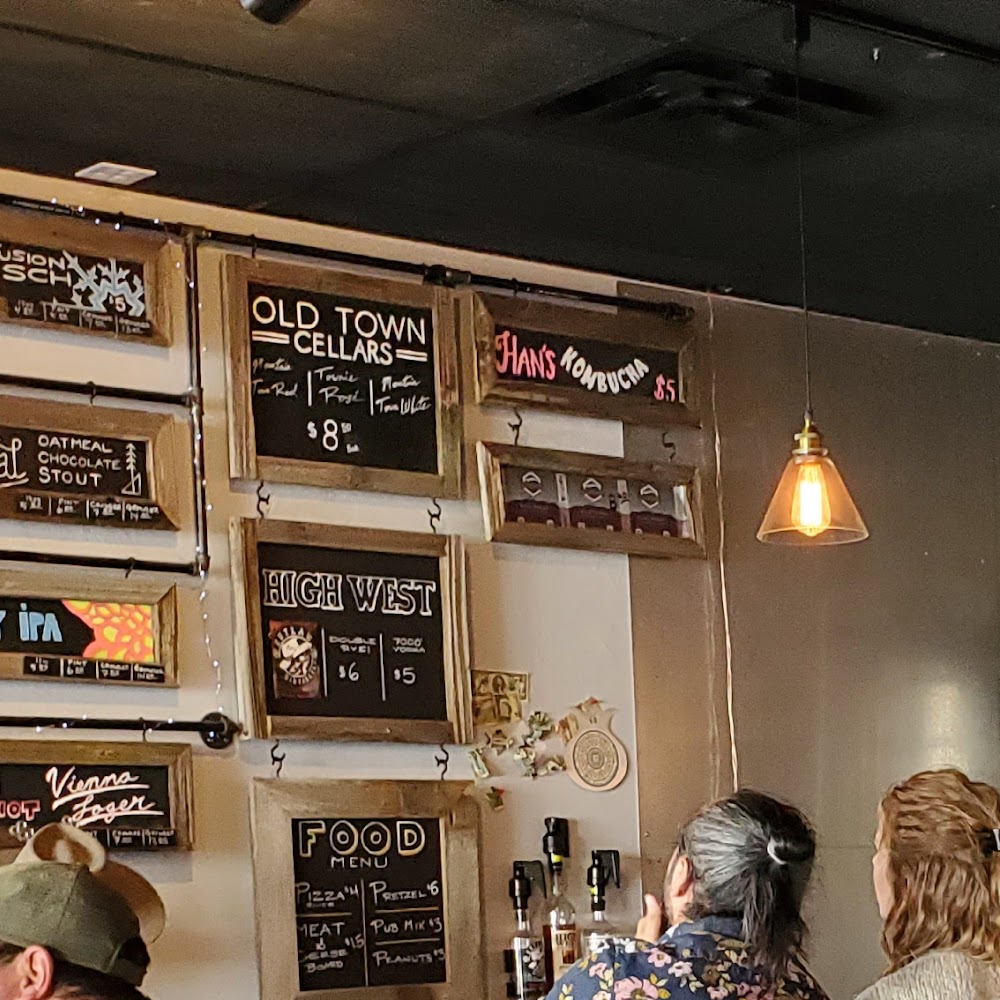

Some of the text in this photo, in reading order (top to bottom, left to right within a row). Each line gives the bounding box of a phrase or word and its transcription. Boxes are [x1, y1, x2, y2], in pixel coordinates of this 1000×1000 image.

[253, 295, 426, 345] OLD TOWN
[293, 330, 393, 366] CELLARS
[37, 434, 114, 454] OATMEAL
[37, 450, 122, 471] CHOCOLATE
[38, 466, 102, 488] STOUT
[262, 568, 437, 617] HIGH WEST
[45, 766, 140, 799] Vienna
[299, 820, 426, 858] FOOD
[330, 857, 388, 869] MENU
